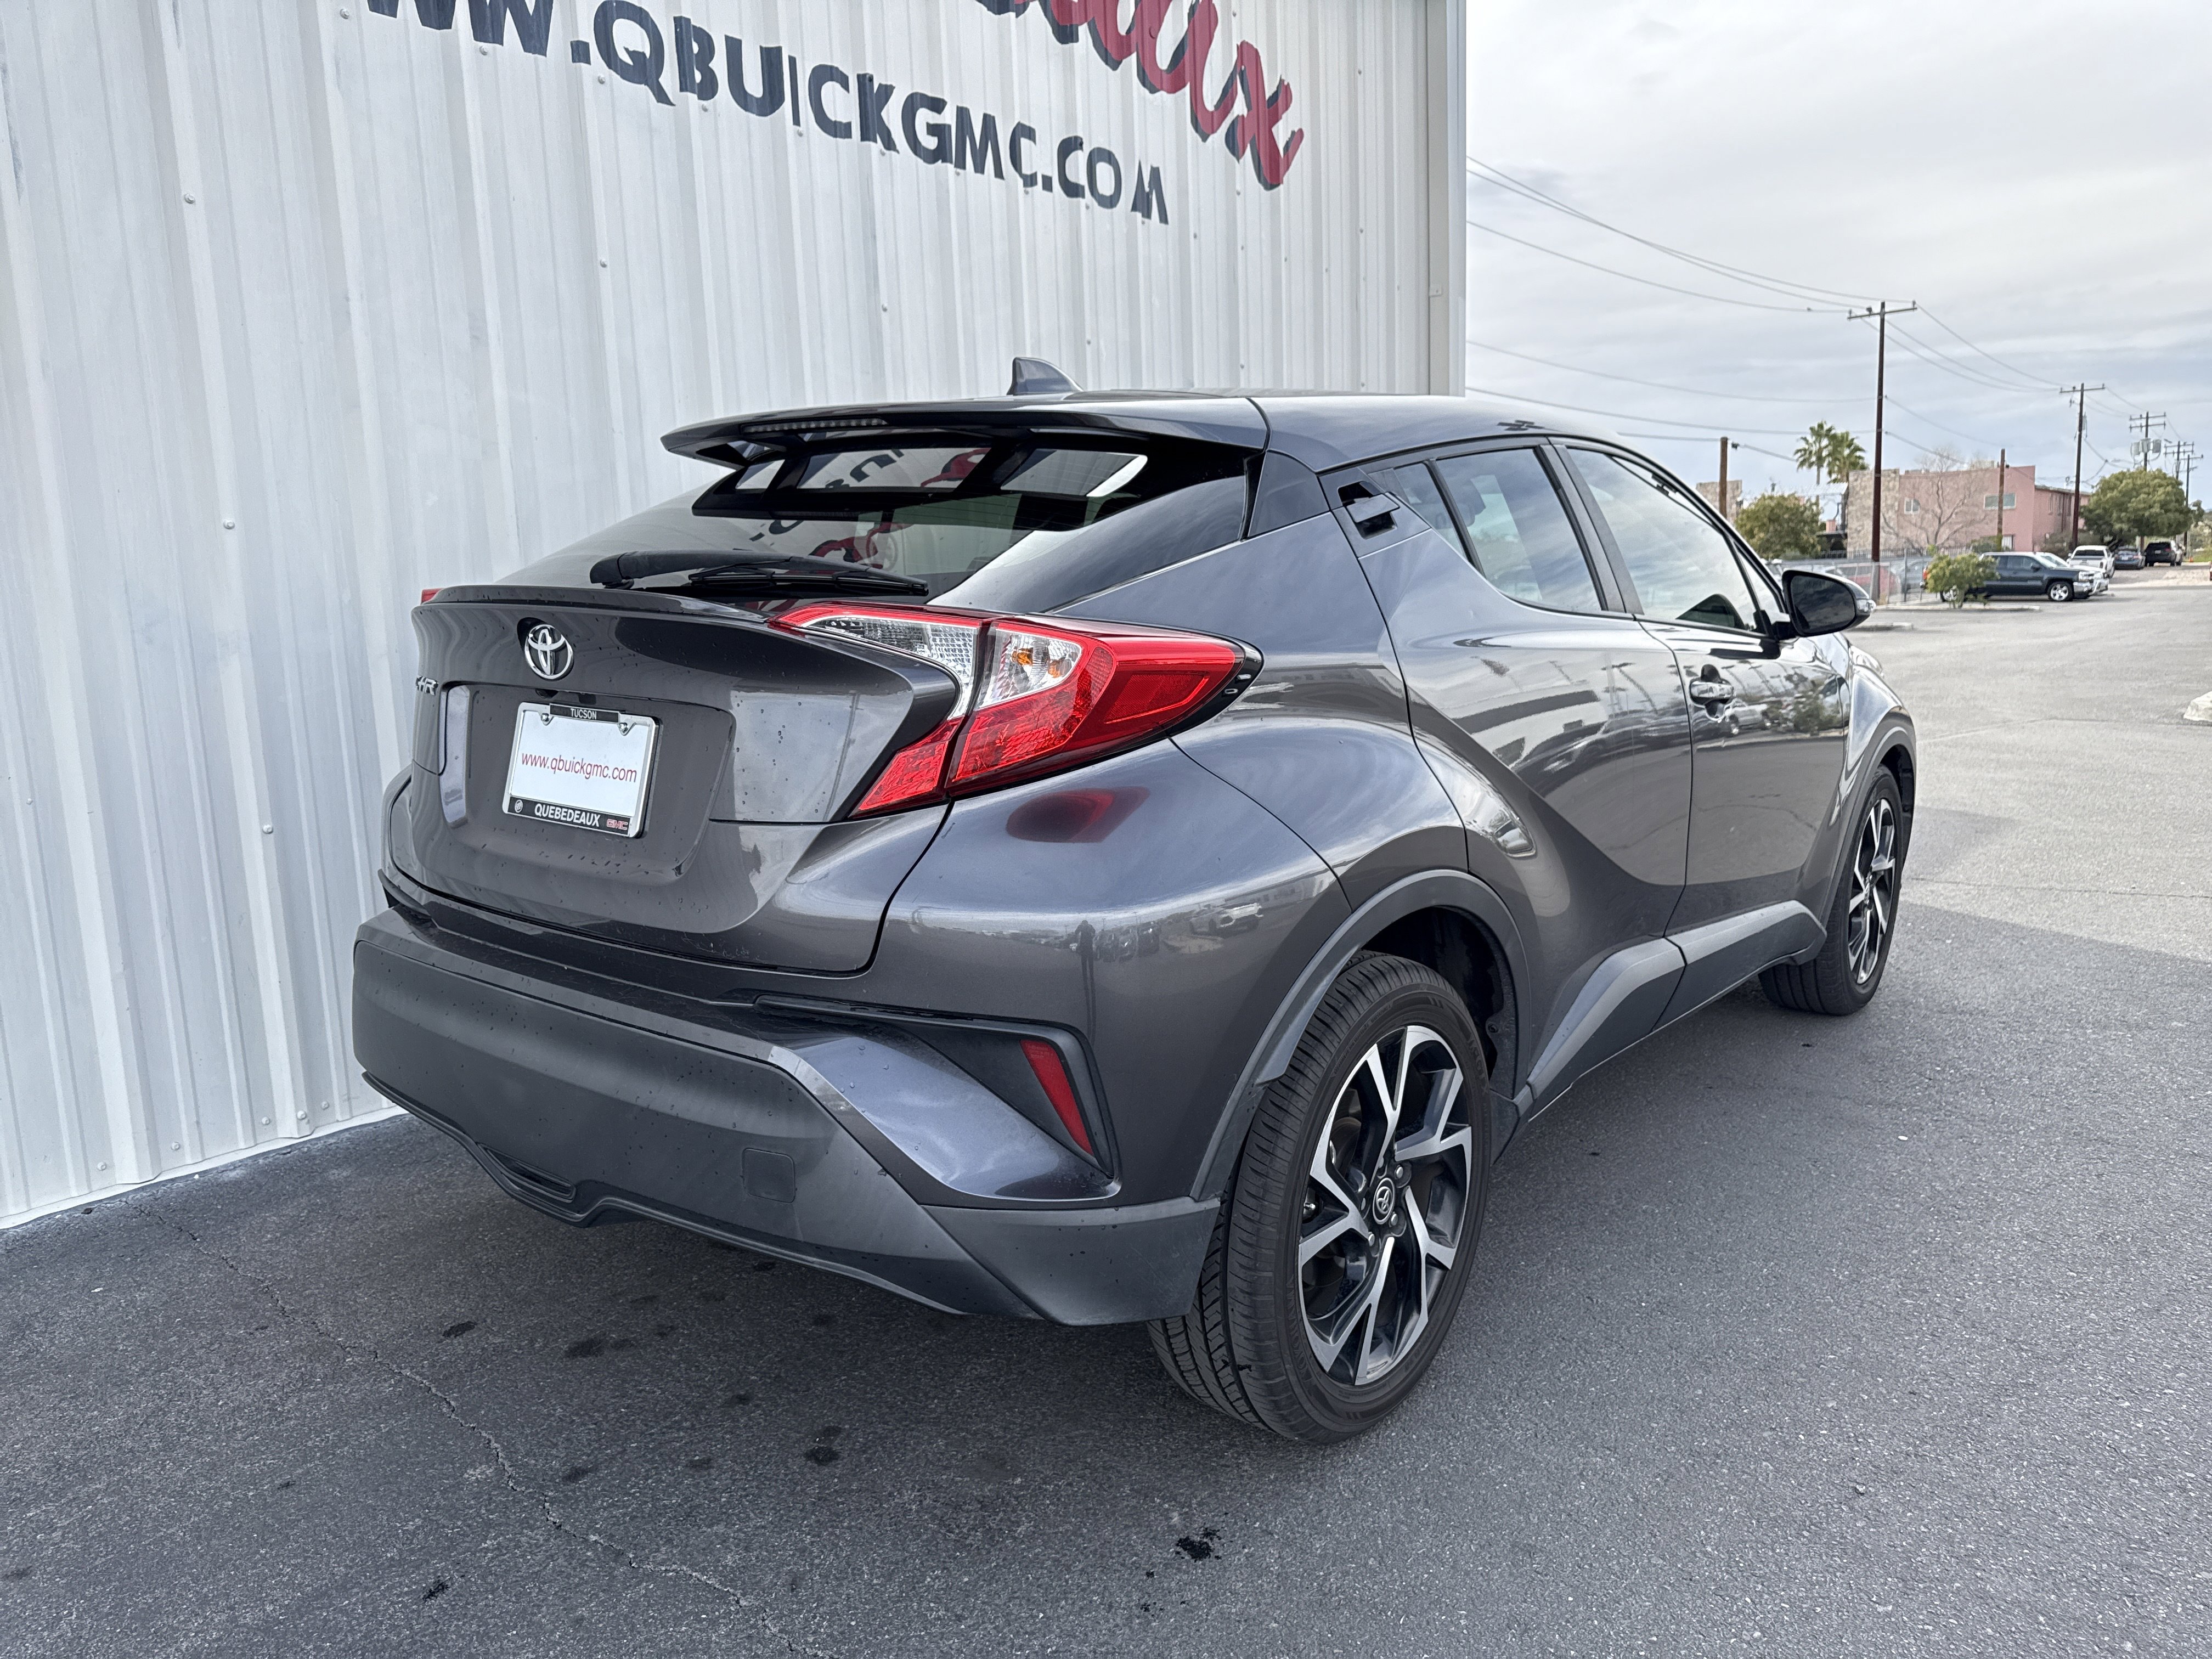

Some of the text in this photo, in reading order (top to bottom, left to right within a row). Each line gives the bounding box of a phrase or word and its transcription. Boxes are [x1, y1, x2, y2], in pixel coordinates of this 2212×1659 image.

[570, 708, 597, 720] TUCSON
[522, 753, 637, 782] www.qbuickgmc.com
[534, 803, 628, 830] QUEBEDEAUX GMC
